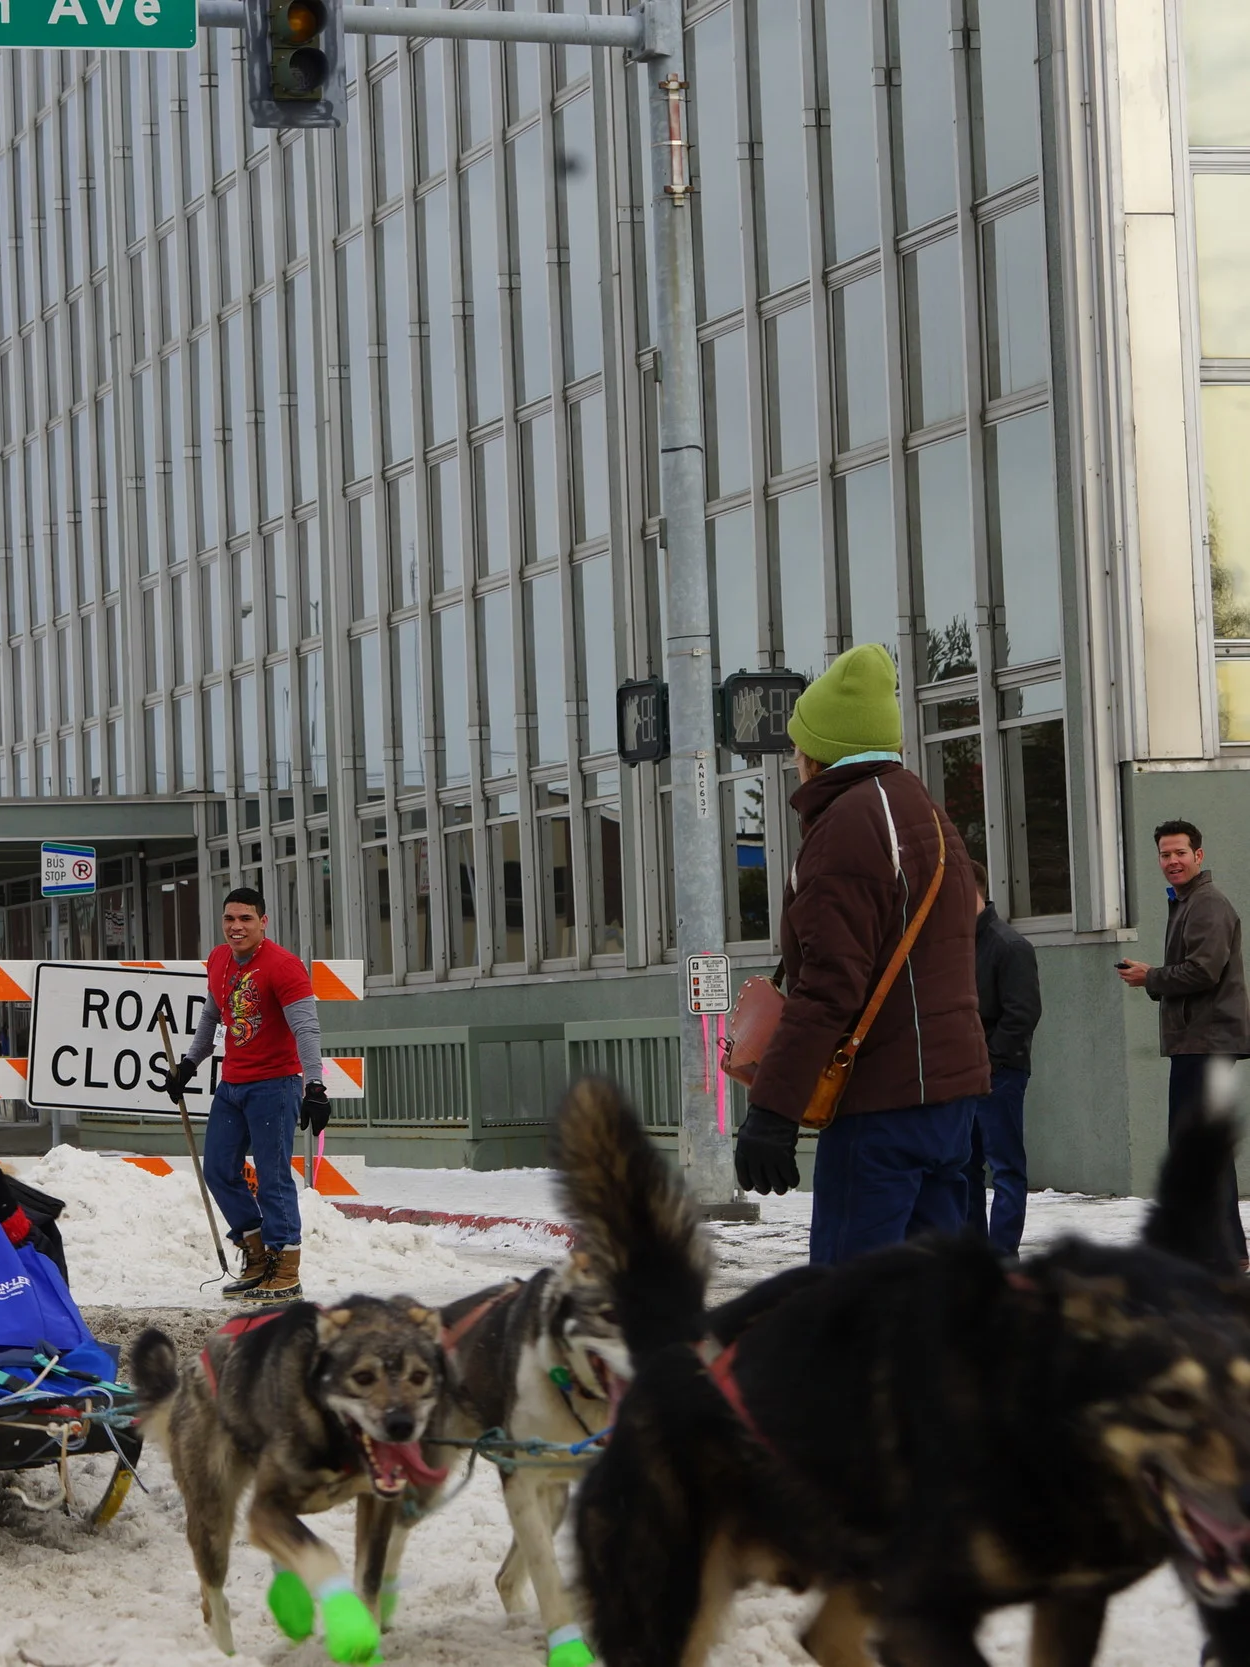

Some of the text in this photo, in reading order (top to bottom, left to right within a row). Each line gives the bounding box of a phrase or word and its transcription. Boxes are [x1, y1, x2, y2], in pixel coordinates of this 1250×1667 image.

[48, 0, 162, 26] Ave
[698, 762, 707, 816] ANC637
[45, 871, 67, 881] STOP
[46, 858, 65, 868] BUS
[82, 988, 208, 1035] ROAD
